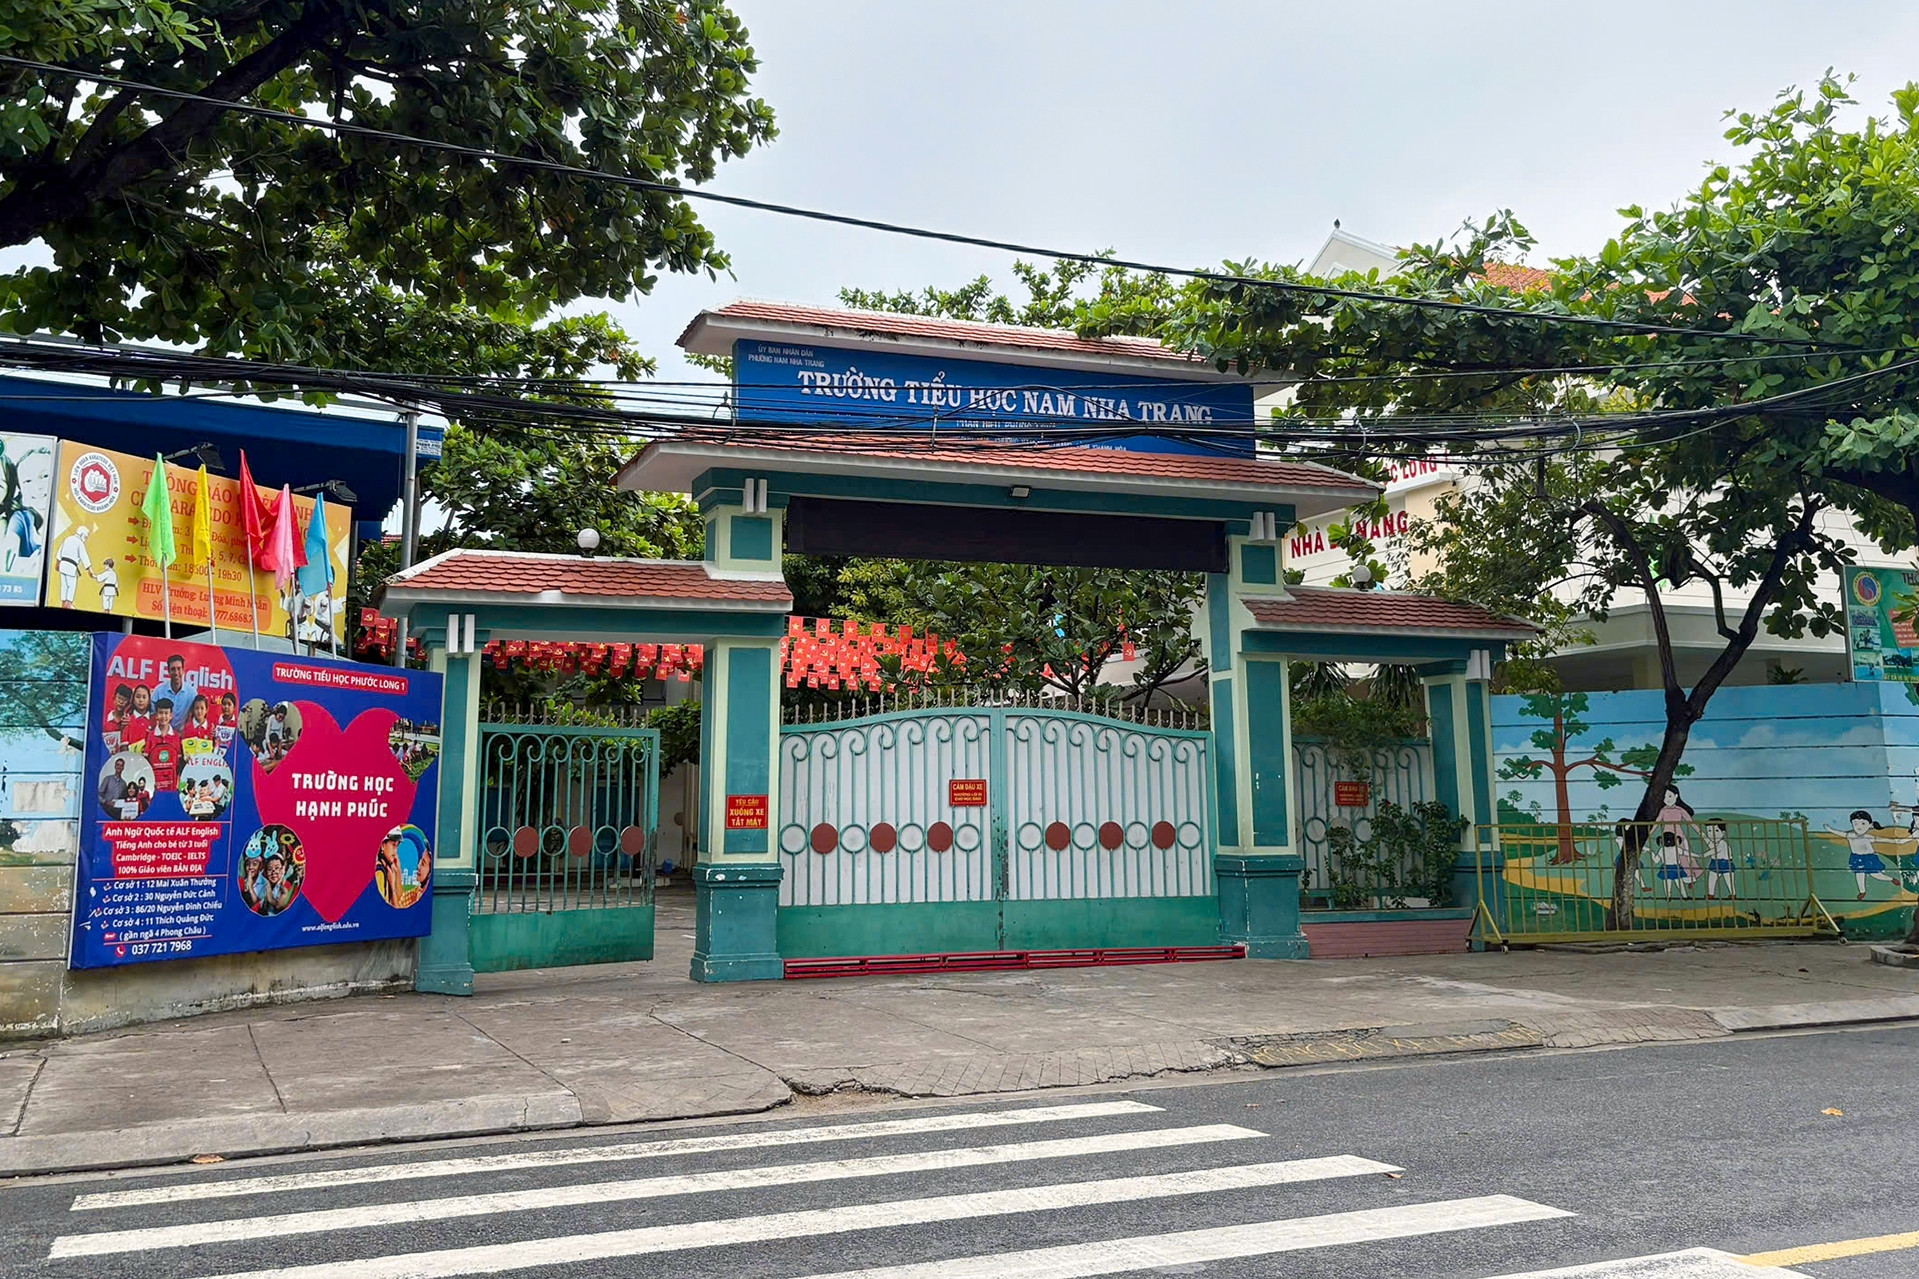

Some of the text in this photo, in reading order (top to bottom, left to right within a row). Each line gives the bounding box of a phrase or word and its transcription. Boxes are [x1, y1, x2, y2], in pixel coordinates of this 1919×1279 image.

[768, 346, 781, 355] BAN
[774, 356, 788, 365] NAM
[789, 358, 803, 367] NHA
[804, 359, 825, 368] TRANG
[798, 366, 1213, 426] TRƯỜNG TIỂU HỌC NAM NHA TRANG
[1402, 453, 1437, 479] LONG
[143, 470, 232, 503] TÔNG ÁO
[171, 499, 232, 524] ARADO
[1291, 526, 1324, 559] NHÀ
[218, 568, 242, 580] 19h30
[143, 583, 268, 610] HLV rưởng: Lưng Minh Nân
[152, 599, 163, 611] Số
[170, 604, 183, 615] iện
[107, 655, 233, 690] ALF Eglish
[275, 667, 312, 681] TRƯỜNG
[332, 673, 350, 685] HỌC
[350, 674, 378, 688] PHƯỚC
[379, 679, 400, 690] LONG
[401, 682, 406, 691] 1
[292, 770, 394, 796] TRƯỜNG HỌC
[296, 798, 388, 821] HẠNH PHÚC
[729, 807, 765, 817] XUỐNG XE
[105, 827, 218, 838] Anh Ngữ Quốc tế ALF English
[116, 841, 136, 850] Tiếng
[137, 840, 153, 849] Anh
[154, 840, 167, 848] cho
[168, 840, 178, 848] bé
[178, 840, 188, 848] từ
[187, 840, 193, 848] 3
[116, 852, 156, 863] Cambridge
[161, 852, 182, 860] TOEIC
[187, 852, 206, 860] IELTS
[118, 865, 137, 874] 100%
[138, 864, 155, 873] Giáo
[156, 864, 172, 873] viên
[173, 862, 188, 873] BẢN
[114, 881, 124, 889] Cơ
[125, 880, 135, 889] sở
[136, 880, 140, 888] 1
[146, 880, 155, 888] 12
[155, 879, 169, 888] Mai
[170, 879, 189, 887] Xuân
[190, 878, 217, 887] Thưởng
[112, 894, 123, 902] Cơ
[124, 893, 134, 902] sở
[134, 893, 139, 901] 2
[145, 892, 154, 900] 30
[154, 890, 182, 902] Nguyễn
[183, 890, 197, 899] Đức
[198, 889, 216, 898] Cảnh
[103, 907, 114, 915] Cơ
[114, 905, 124, 915] sở
[125, 905, 130, 914] 3
[135, 904, 156, 914] 86/20
[156, 901, 184, 914] Nguyễn
[112, 919, 123, 928] Cơ
[124, 918, 134, 927] sở
[134, 918, 140, 926] 4
[145, 918, 153, 926] 11
[155, 916, 175, 925] Thích
[176, 914, 199, 924] Quảng
[199, 914, 214, 922] Đức
[123, 930, 138, 941] gần
[139, 930, 154, 941] ngã
[154, 929, 160, 938] 4
[160, 928, 183, 940] Phong
[183, 926, 202, 936] Châu
[131, 940, 192, 956] 037 721 7968
